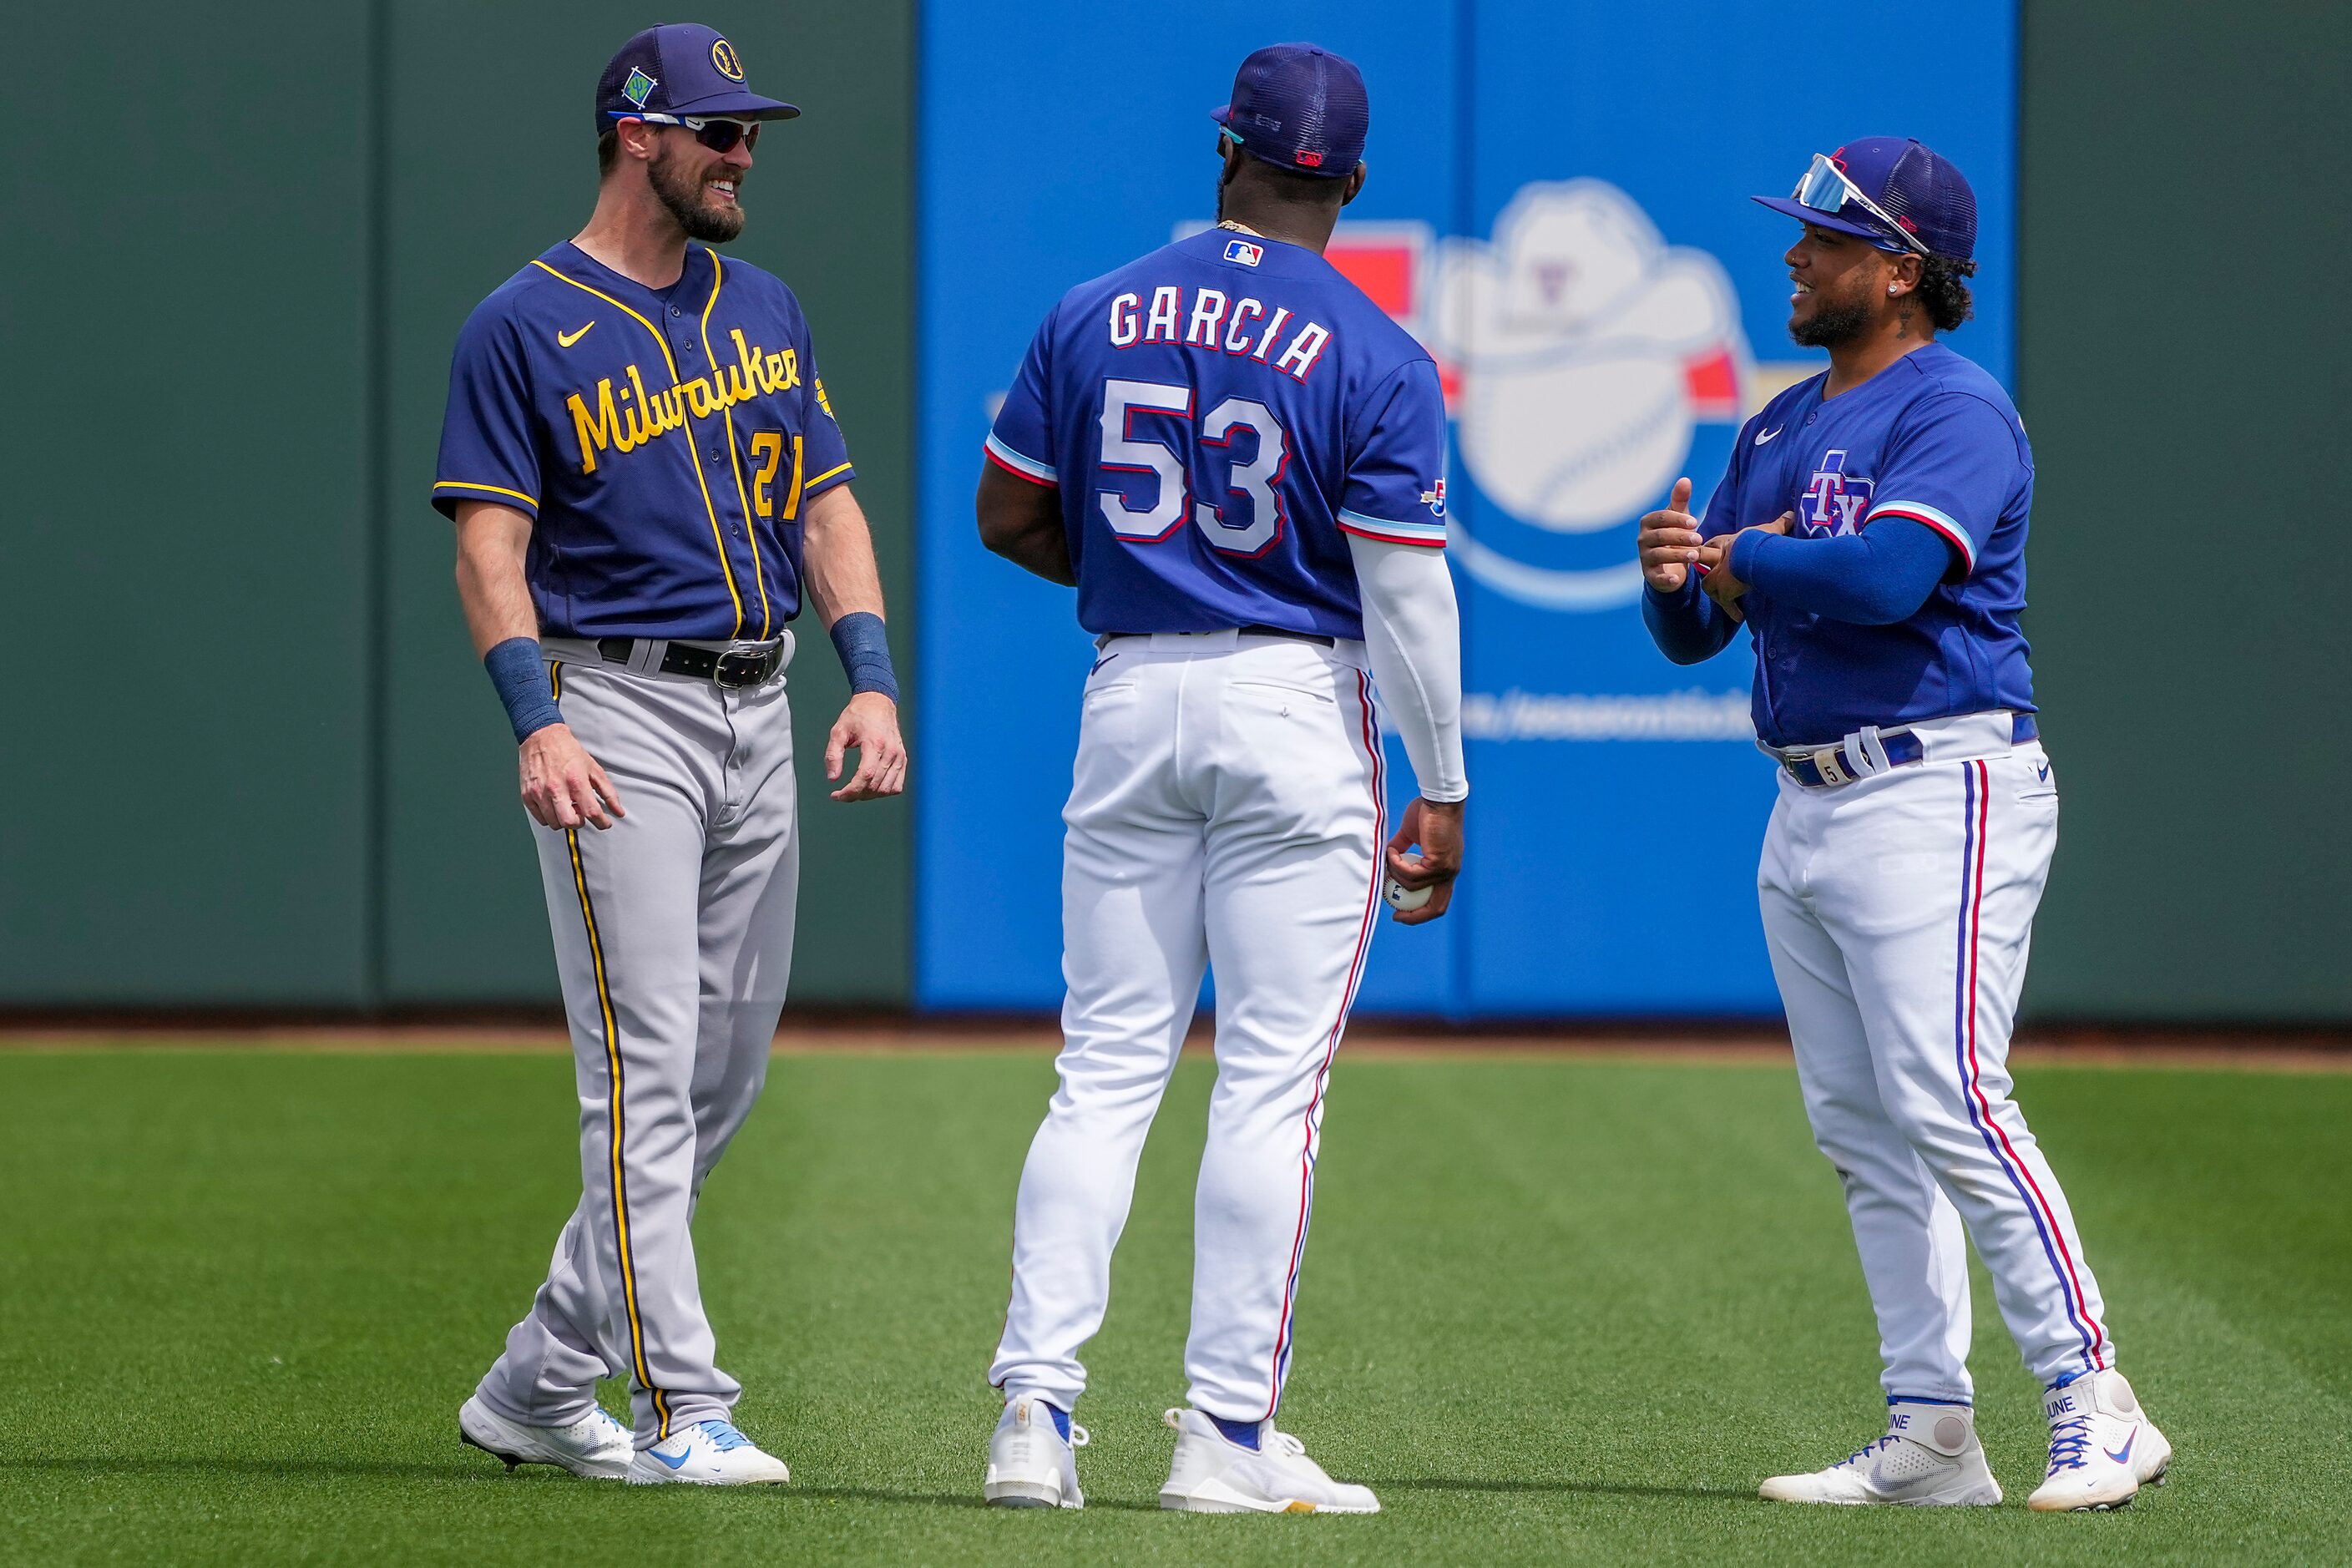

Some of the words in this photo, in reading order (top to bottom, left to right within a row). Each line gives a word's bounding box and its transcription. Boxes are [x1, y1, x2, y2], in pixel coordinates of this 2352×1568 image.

[1107, 286, 1333, 385] GARCIA
[565, 327, 801, 475] Milwaukee
[750, 427, 804, 522] 21
[1095, 376, 1291, 559] 53
[1823, 766, 1838, 782] 5
